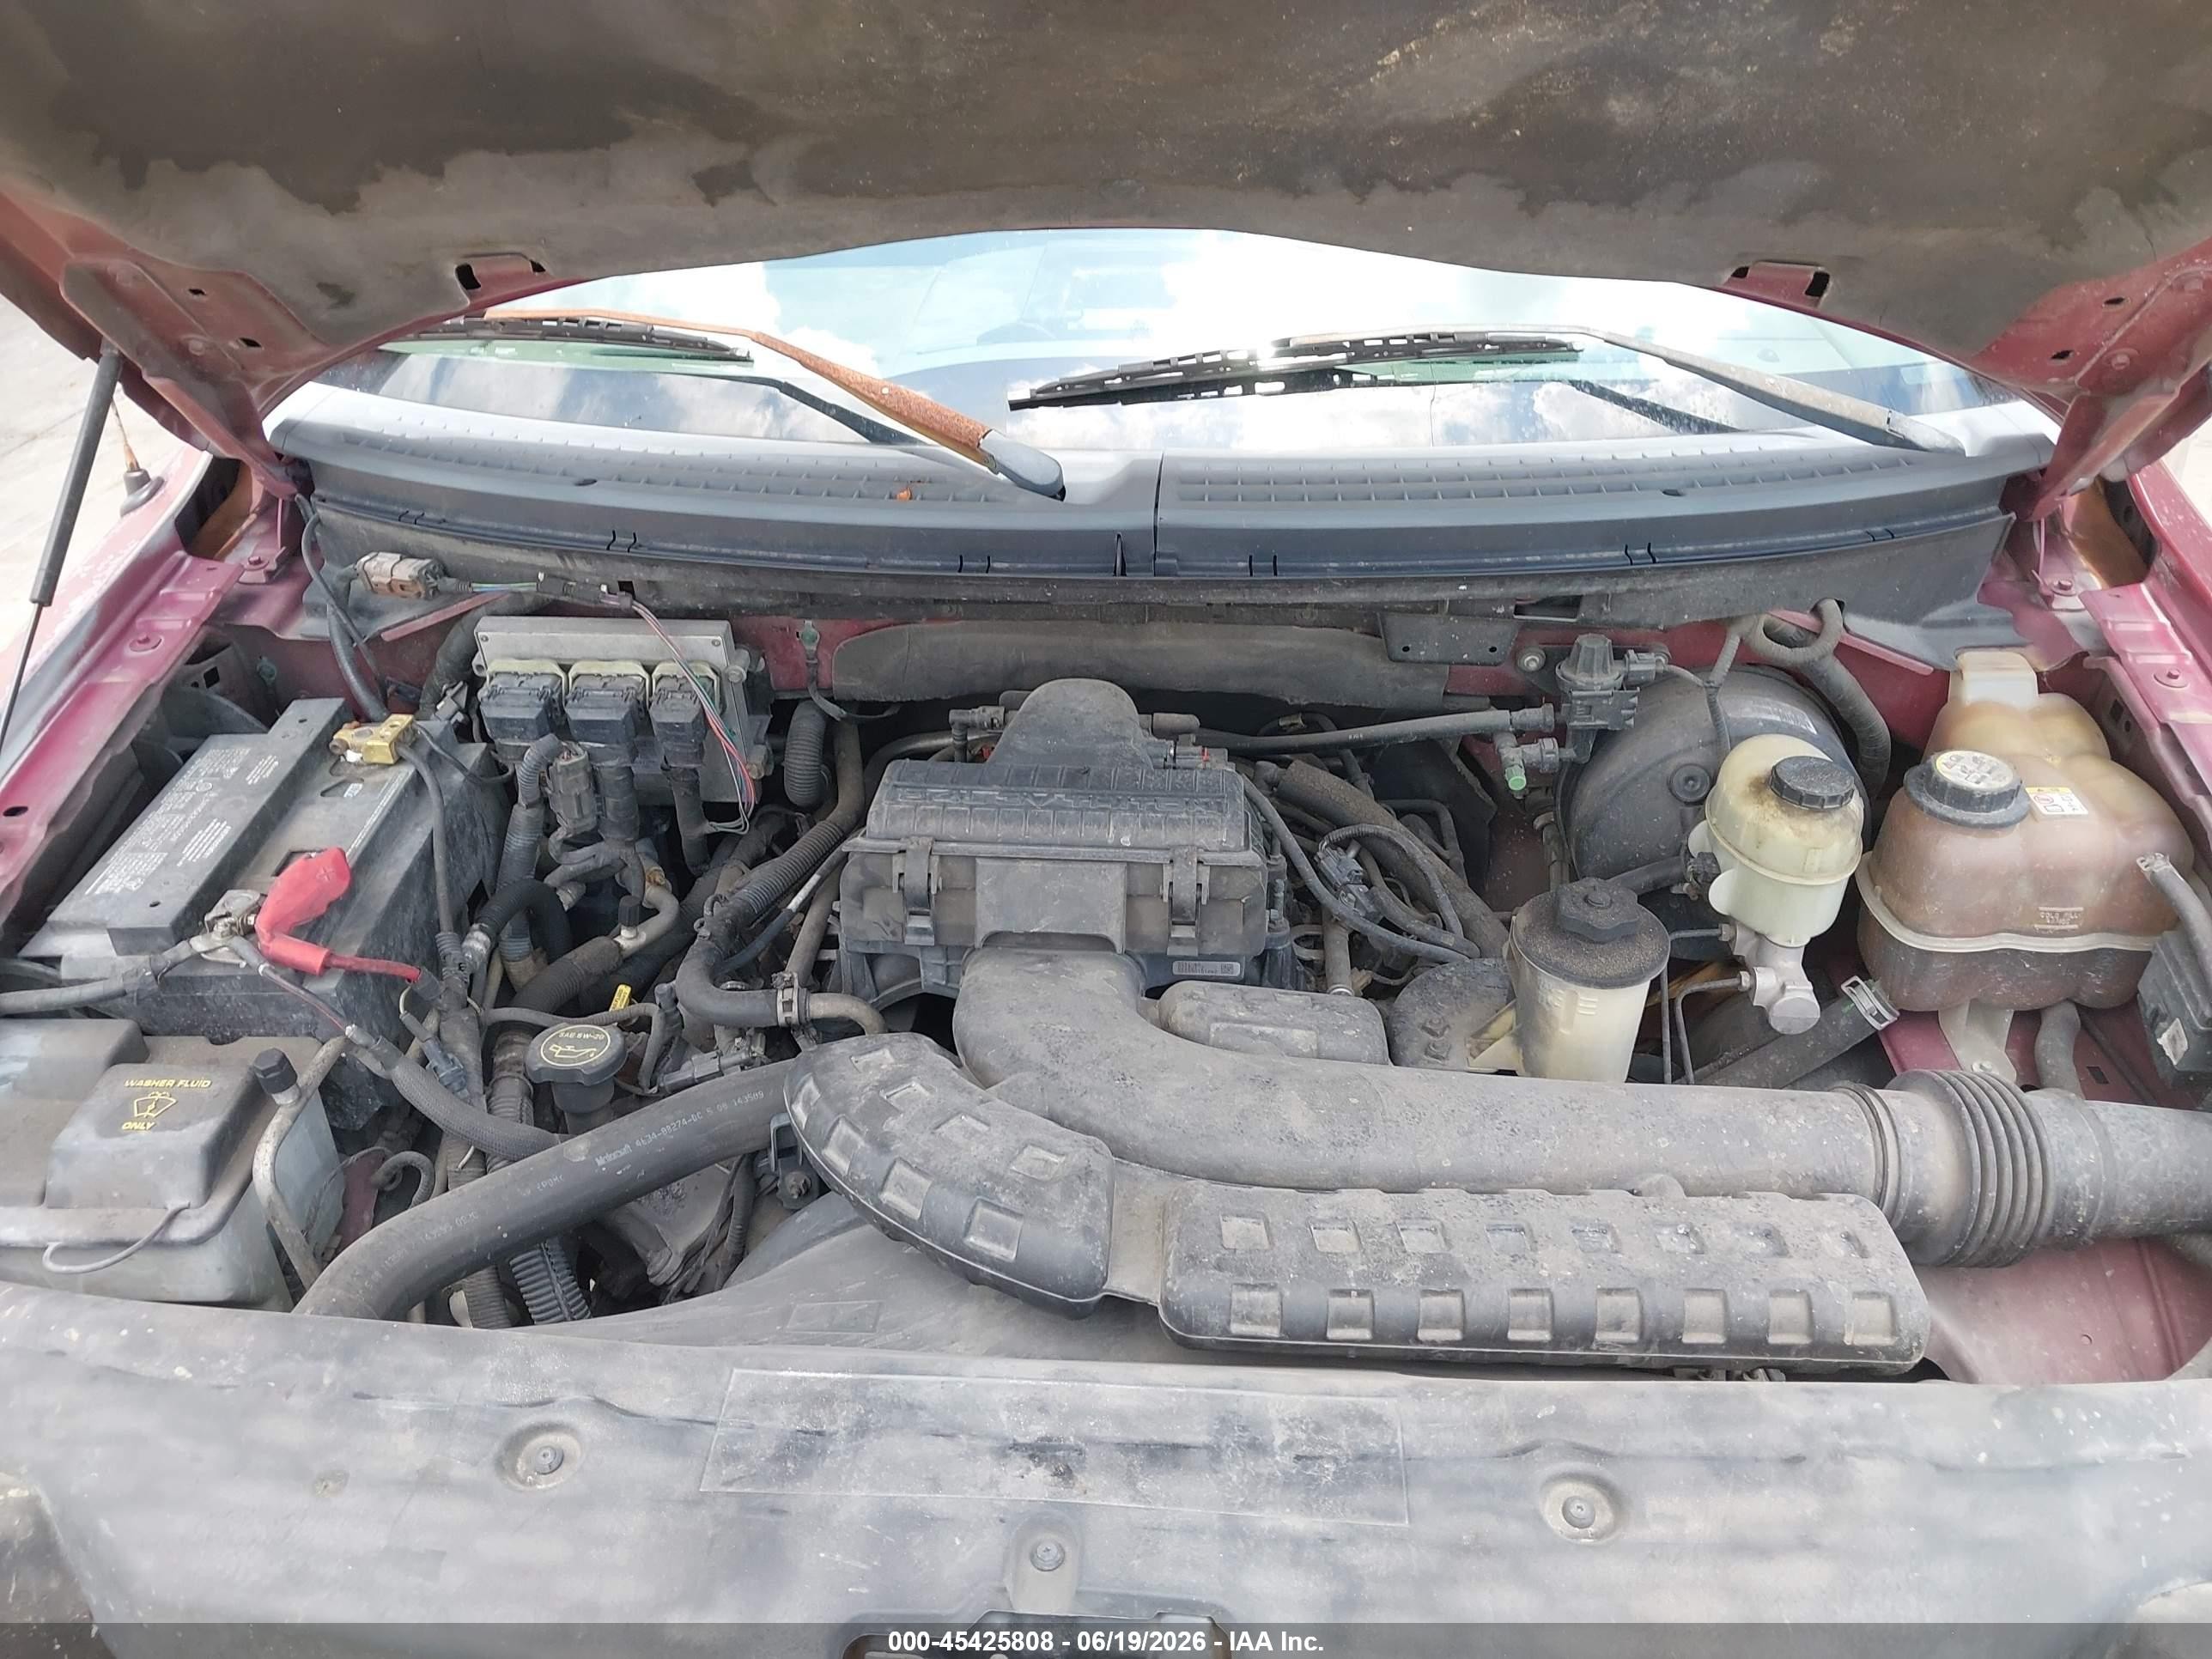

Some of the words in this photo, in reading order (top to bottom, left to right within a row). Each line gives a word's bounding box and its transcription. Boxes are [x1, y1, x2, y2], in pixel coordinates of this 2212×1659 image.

[124, 1079, 175, 1088] WASHER
[177, 1079, 213, 1088] FLUID
[122, 1121, 155, 1131] ONLY
